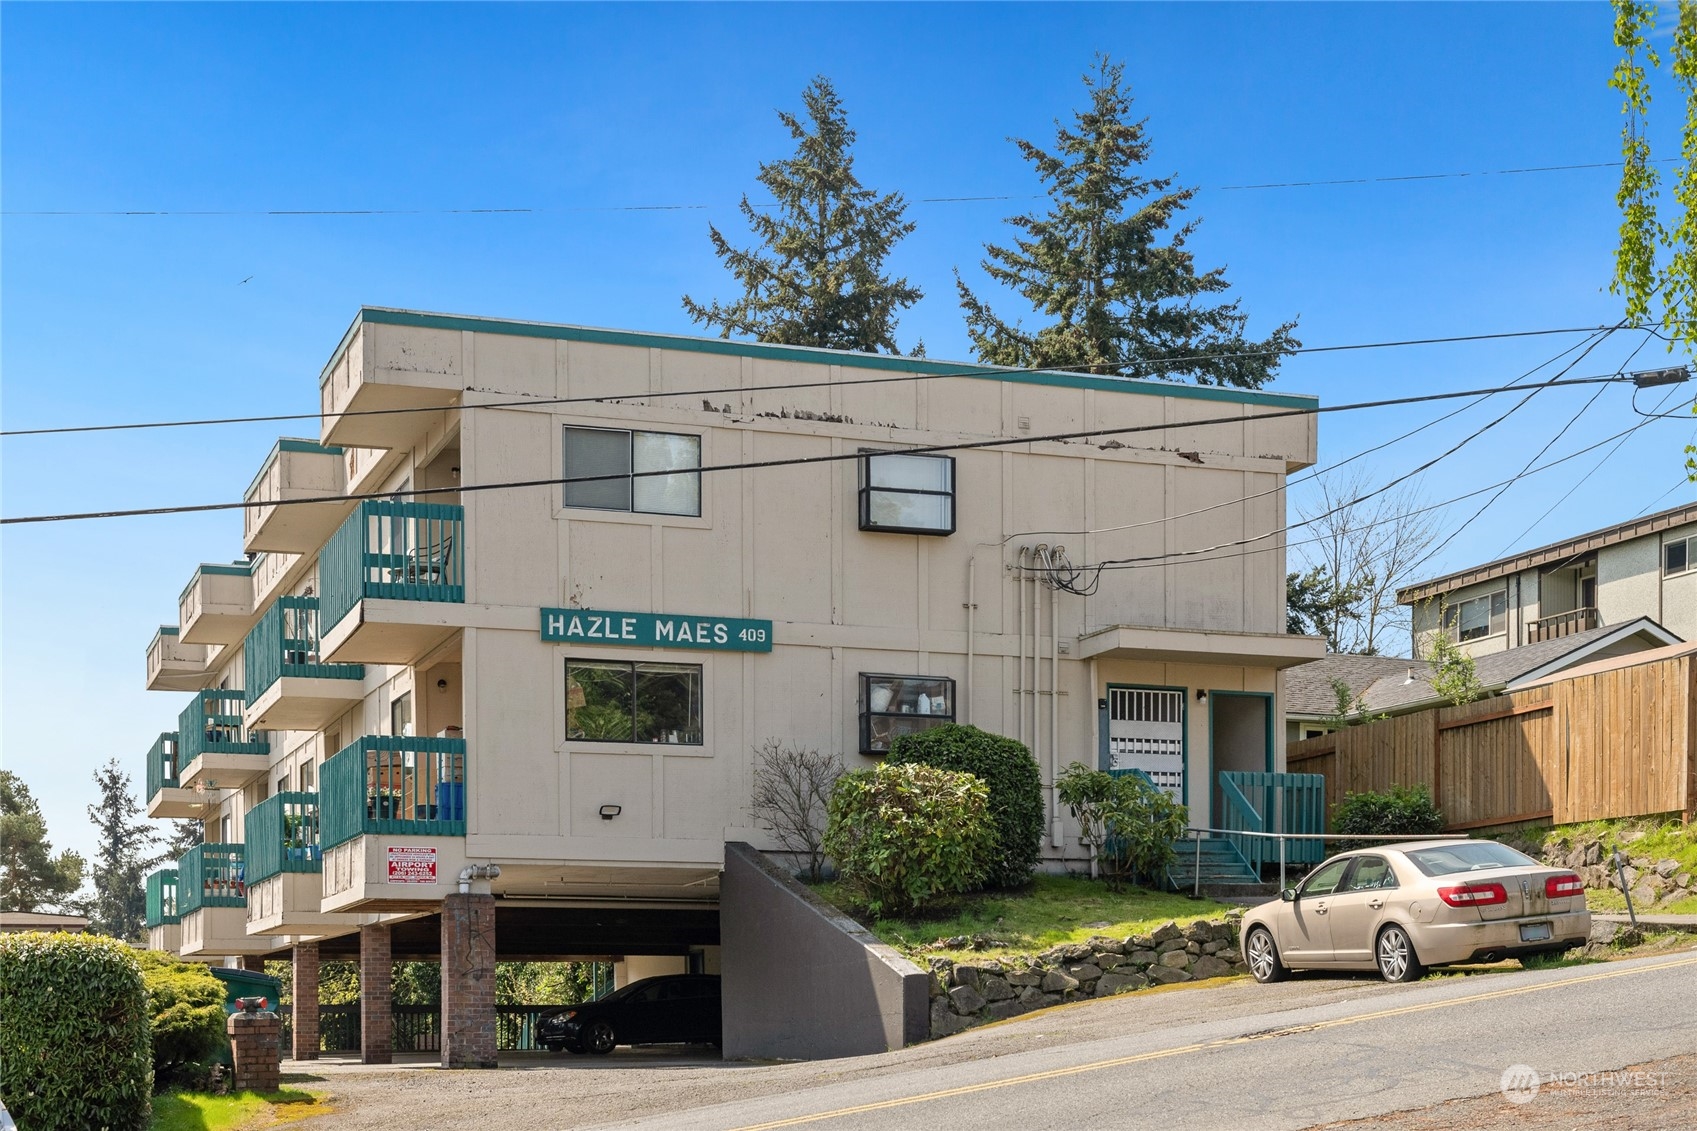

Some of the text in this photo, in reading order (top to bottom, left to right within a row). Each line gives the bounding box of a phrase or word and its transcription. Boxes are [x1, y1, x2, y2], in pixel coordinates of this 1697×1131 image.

[548, 614, 766, 644] HAZLE MAES 409
